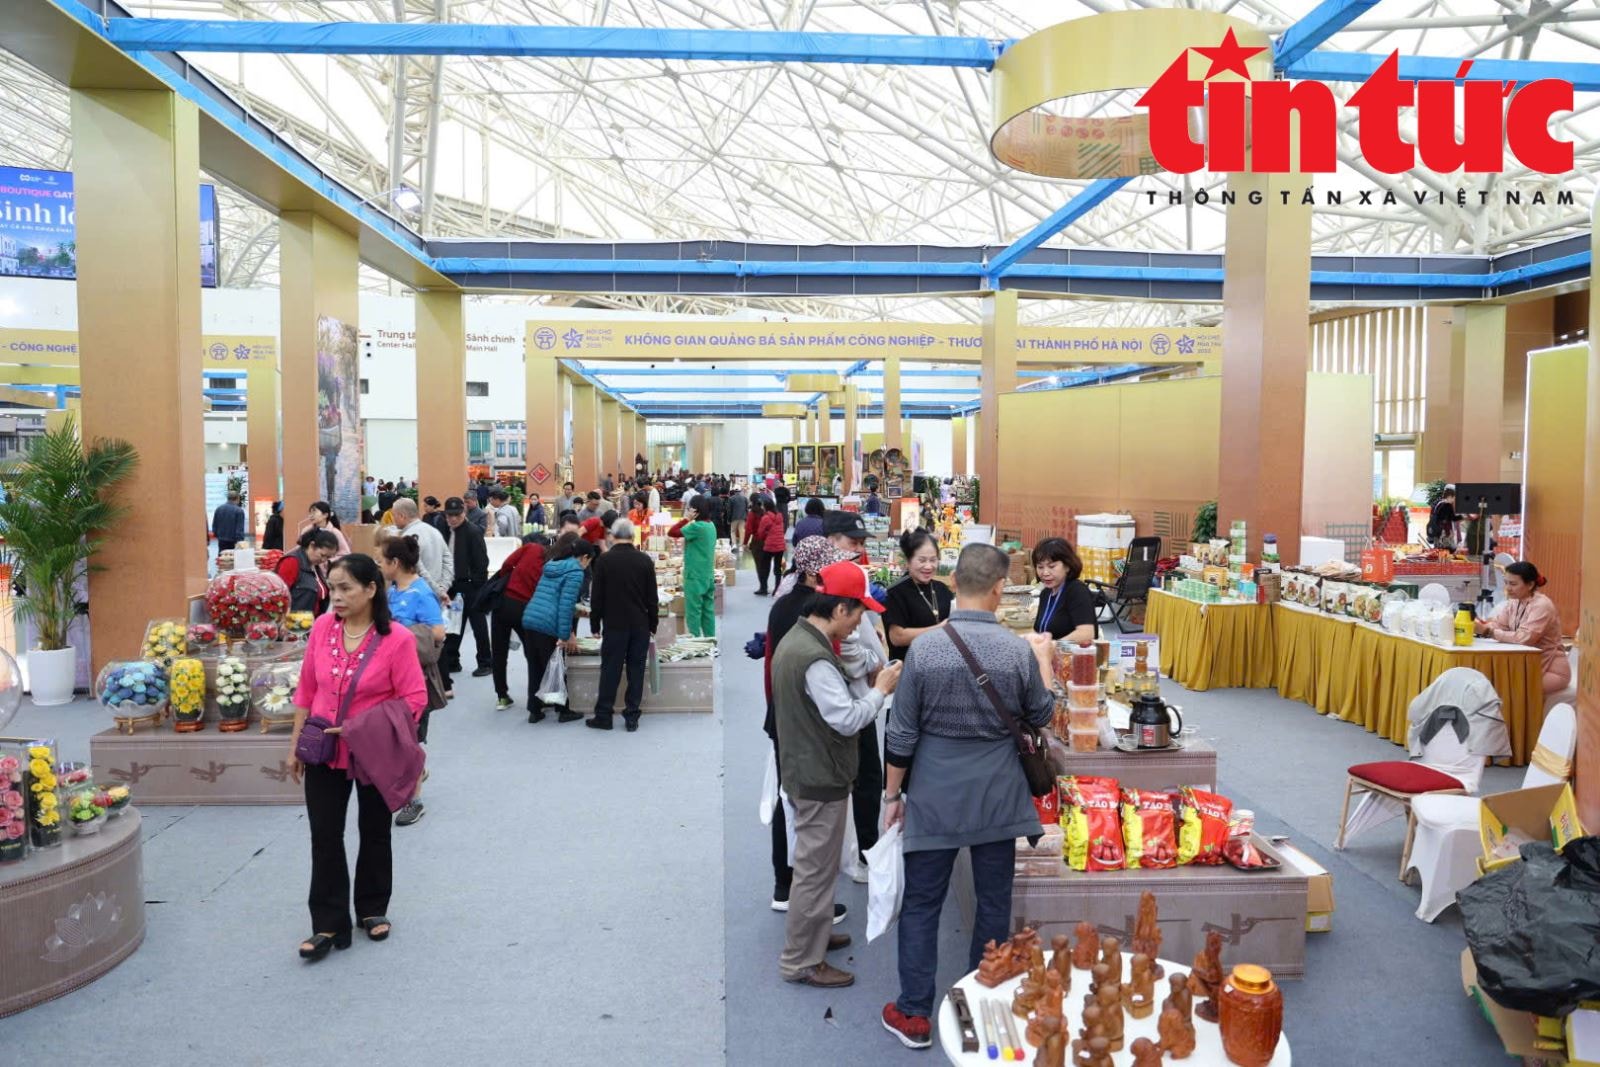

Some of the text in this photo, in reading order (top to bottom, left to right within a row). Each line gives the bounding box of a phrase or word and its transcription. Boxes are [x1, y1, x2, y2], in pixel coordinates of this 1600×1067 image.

[625, 332, 671, 345] KHÔNG
[674, 335, 706, 345] GIAN
[709, 331, 756, 345] QUẢNG
[848, 333, 885, 346] CÔNG
[889, 334, 935, 348] NGHIỆP
[1102, 338, 1119, 350] HÀ
[1122, 337, 1143, 352] NỘI
